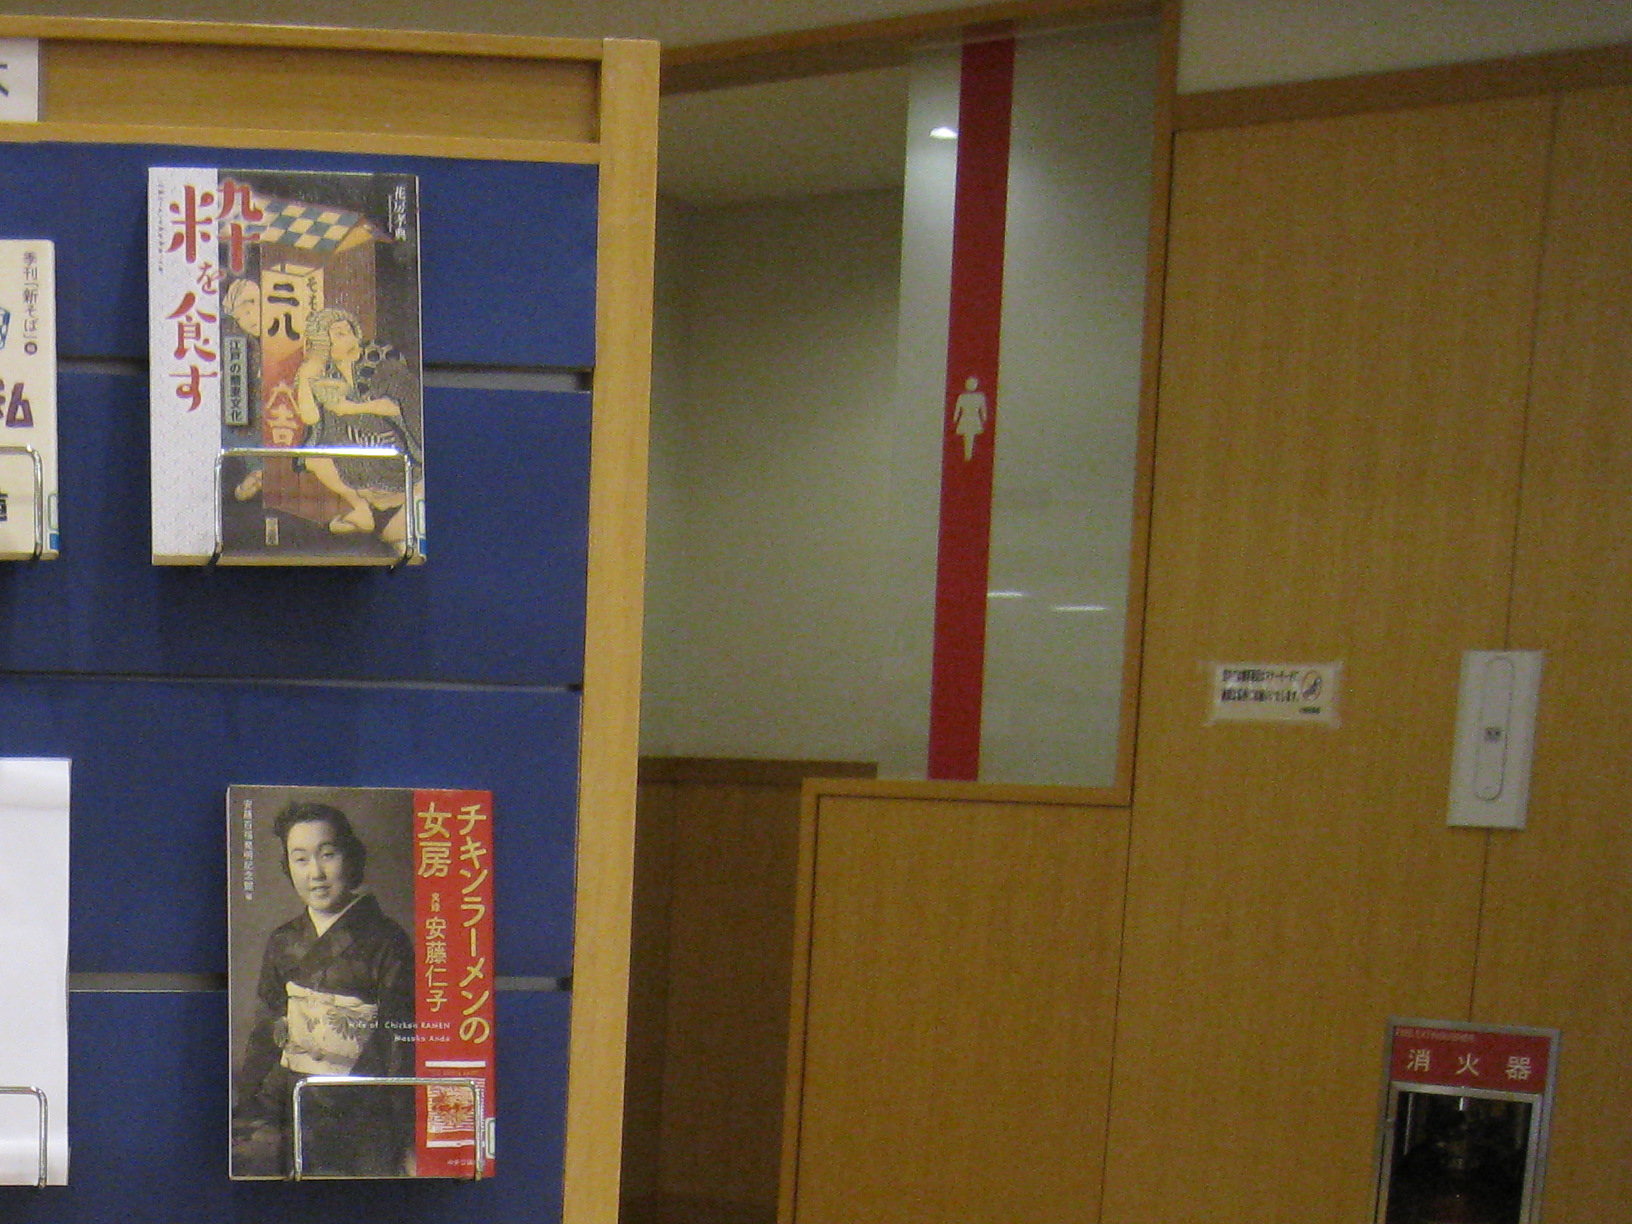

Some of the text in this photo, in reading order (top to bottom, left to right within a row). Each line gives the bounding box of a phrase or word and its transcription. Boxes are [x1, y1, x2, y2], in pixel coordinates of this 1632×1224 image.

[417, 802, 453, 879] 女房
[456, 803, 491, 1044] チキンラーメンの
[425, 916, 448, 1012] 安藤仁子
[421, 1021, 451, 1029] RAMEN
[1407, 1049, 1532, 1080] 消火器
